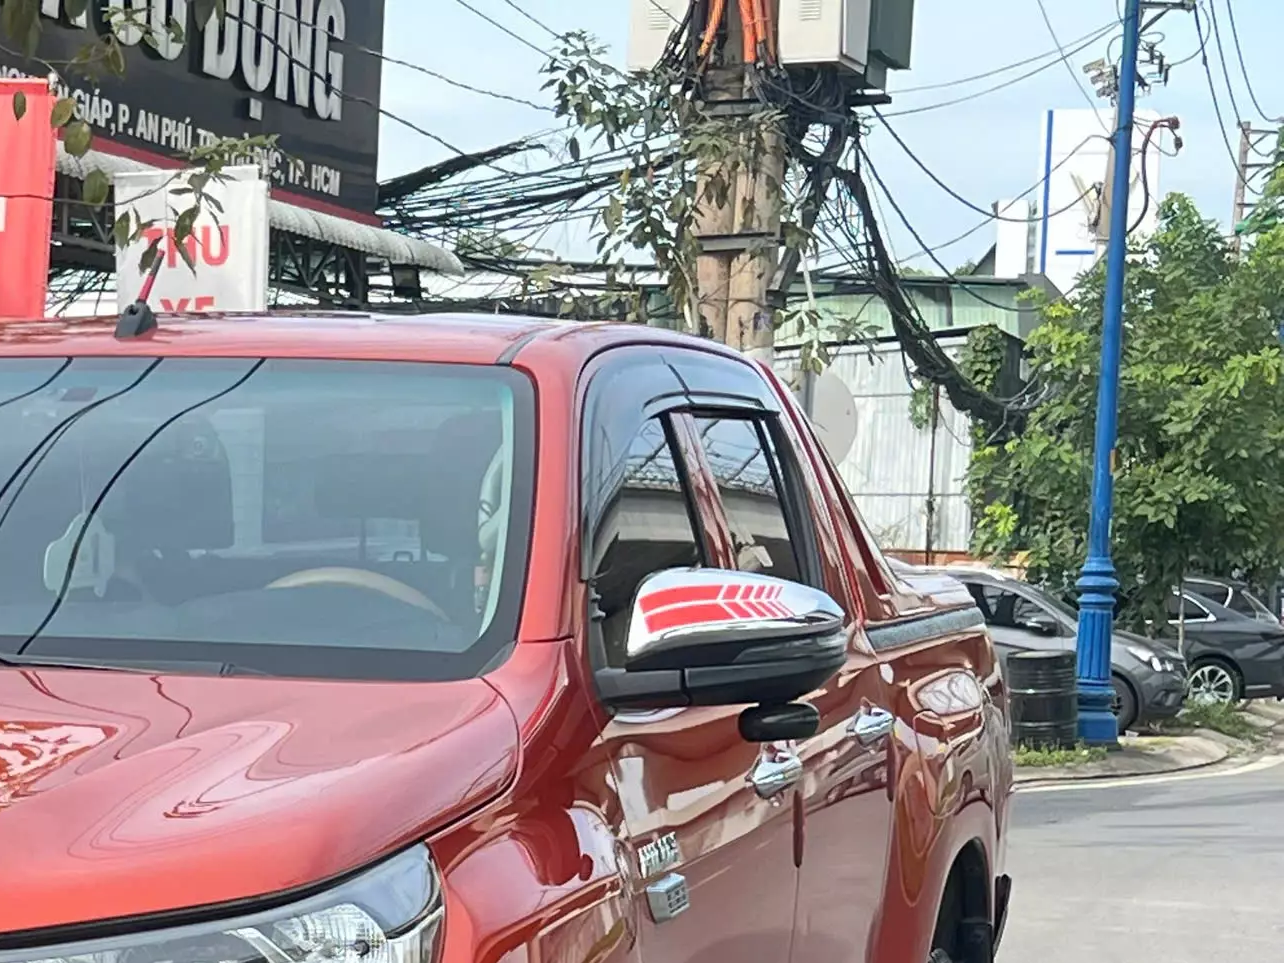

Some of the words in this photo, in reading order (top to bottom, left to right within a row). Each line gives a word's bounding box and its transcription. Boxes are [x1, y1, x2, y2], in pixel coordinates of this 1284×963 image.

[118, 103, 133, 136] P.
[135, 109, 159, 144] AN
[311, 163, 341, 196] HCM
